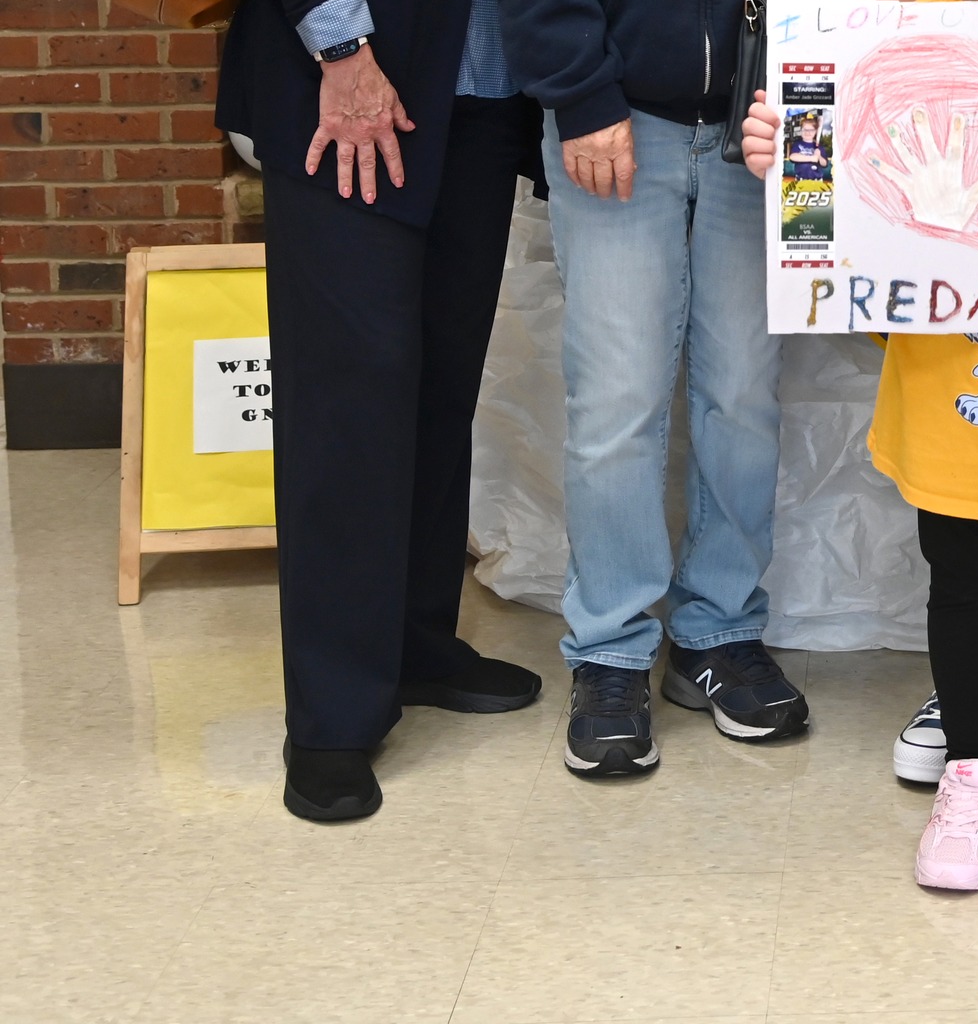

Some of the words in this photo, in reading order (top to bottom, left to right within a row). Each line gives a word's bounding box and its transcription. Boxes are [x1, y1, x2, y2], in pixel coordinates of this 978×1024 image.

[773, 14, 800, 44] I
[817, 5, 919, 33] LOVE
[940, 8, 965, 27] U
[784, 190, 832, 207] 2025
[232, 383, 271, 398] TO
[955, 769, 973, 777] NIKE
